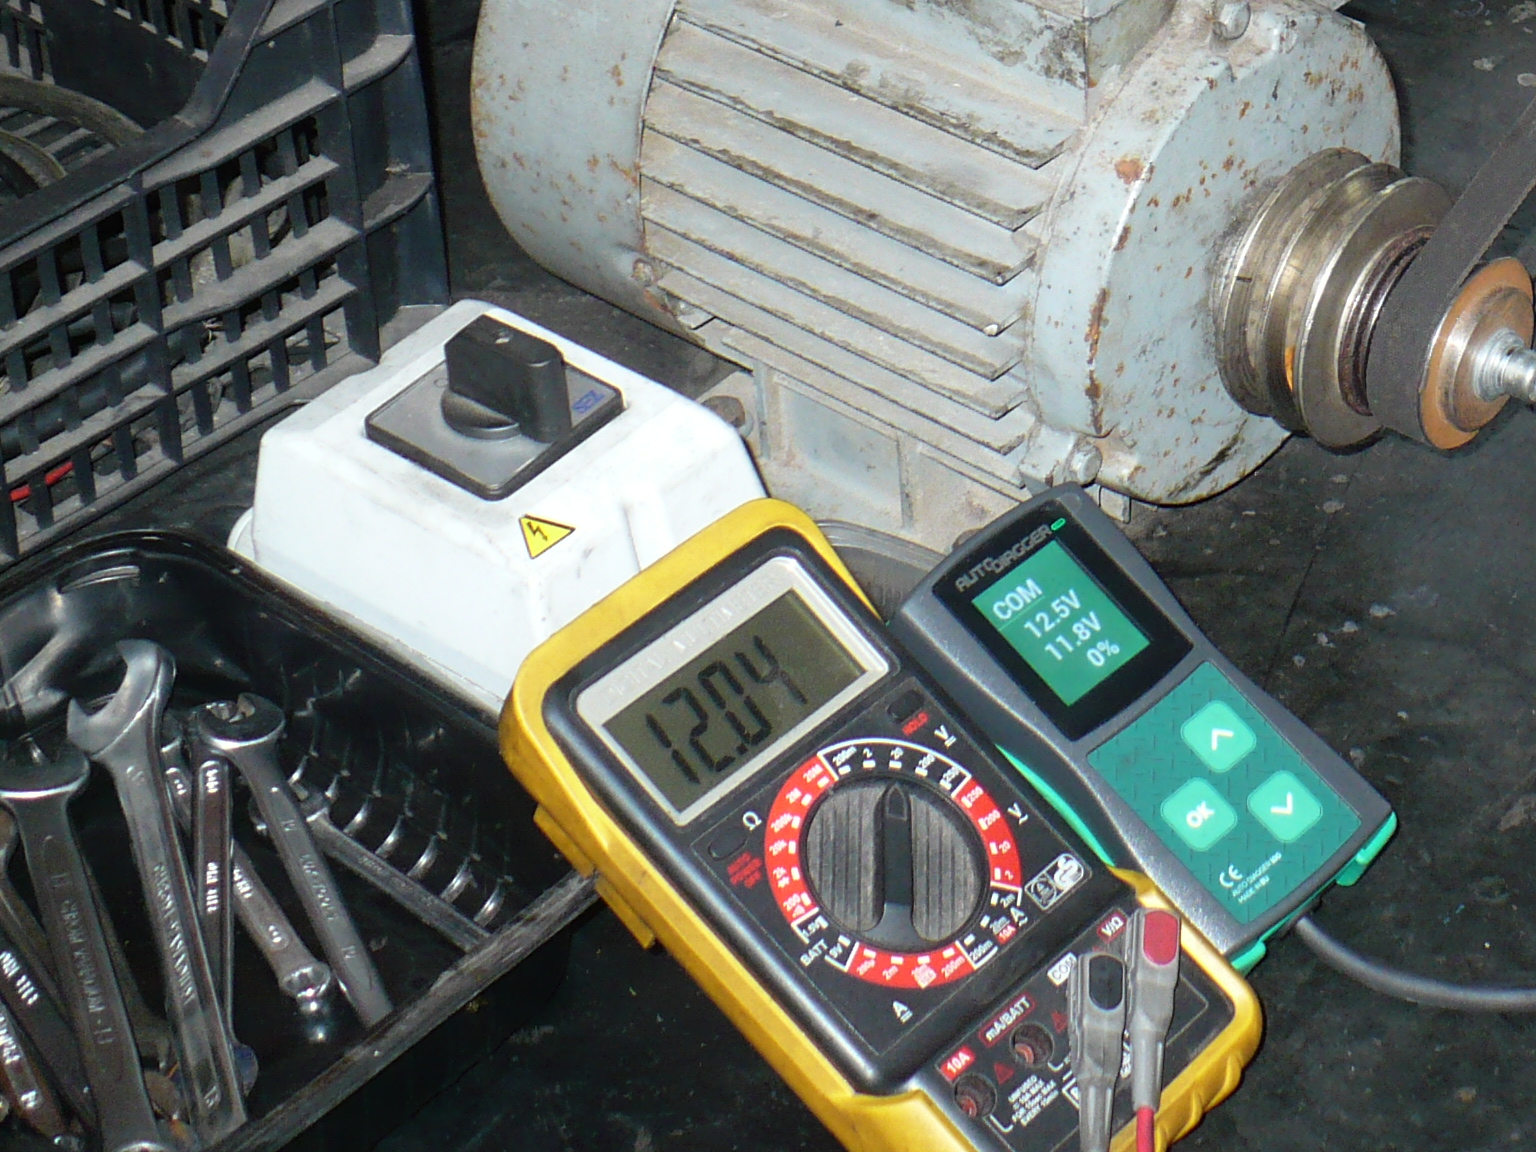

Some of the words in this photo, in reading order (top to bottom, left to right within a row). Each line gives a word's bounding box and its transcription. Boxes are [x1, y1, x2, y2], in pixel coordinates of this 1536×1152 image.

[992, 578, 1043, 620] COM
[1024, 588, 1081, 638] 12.5V
[1045, 611, 1102, 661] 11.8V
[1087, 640, 1120, 667] 0%
[645, 634, 808, 784] 12.04
[1186, 800, 1215, 829] OK
[800, 938, 828, 967] BATT
[969, 939, 993, 962] 200m
[985, 996, 1032, 1042] mA/BATT
[946, 1052, 971, 1076] 10A
